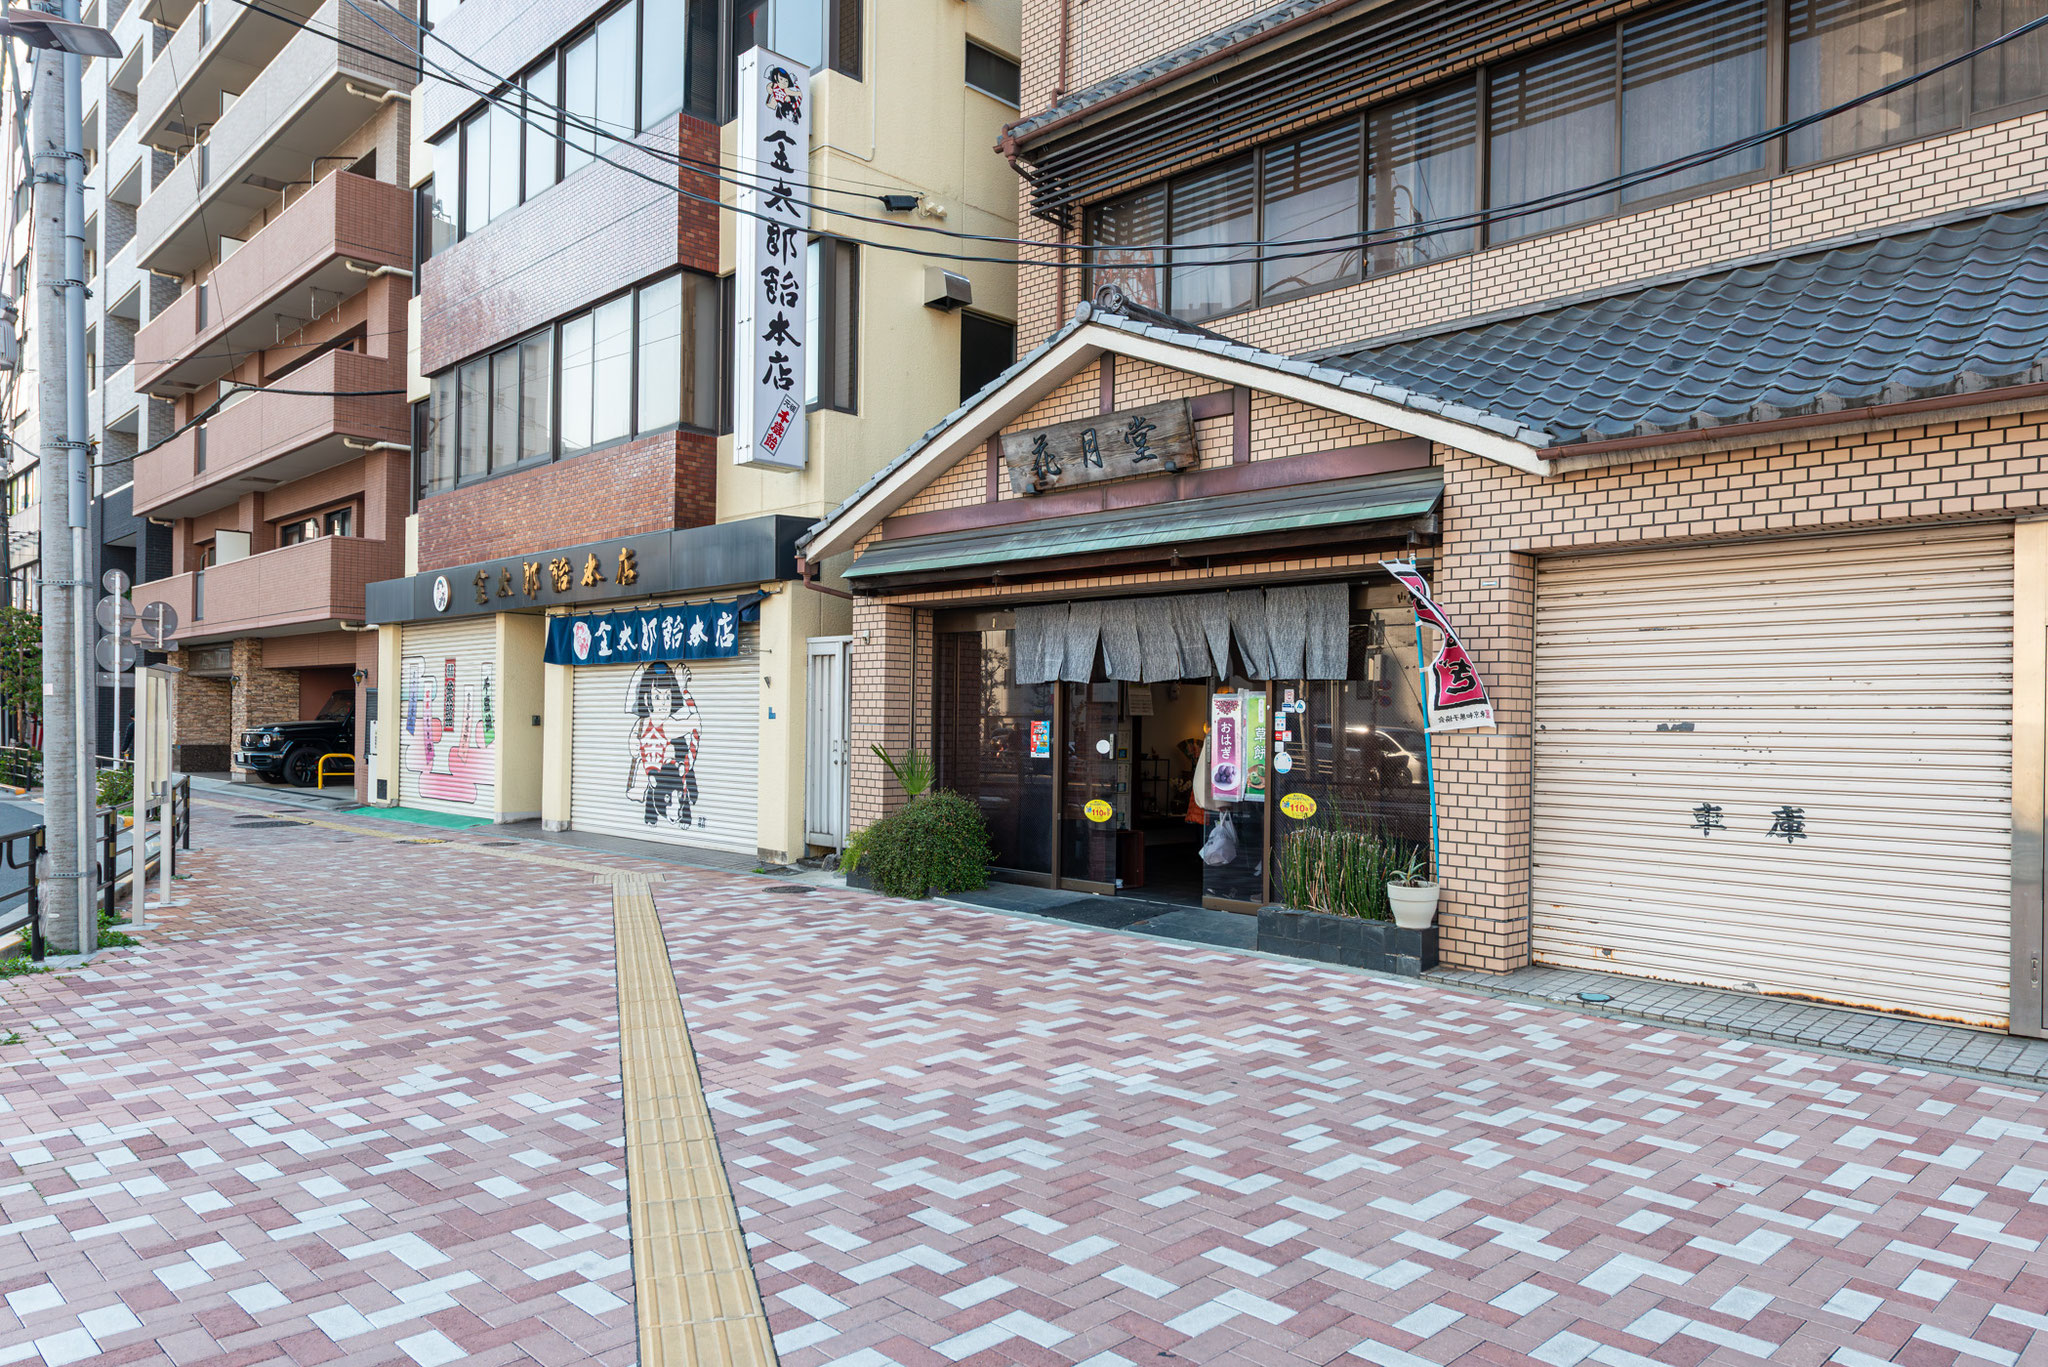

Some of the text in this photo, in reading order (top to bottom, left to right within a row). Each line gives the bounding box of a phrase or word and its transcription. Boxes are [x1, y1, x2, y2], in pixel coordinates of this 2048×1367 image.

[760, 129, 802, 391] 金太郎飴本店
[783, 398, 797, 414] 元祖
[764, 409, 790, 451] 千歳飴
[1031, 415, 1158, 487] 花月堂
[473, 547, 638, 605] 金太郎飴本店
[594, 611, 736, 657] 金太郎飴本店
[1220, 721, 1233, 760] おはぎ
[1689, 802, 1808, 844] 車庫
